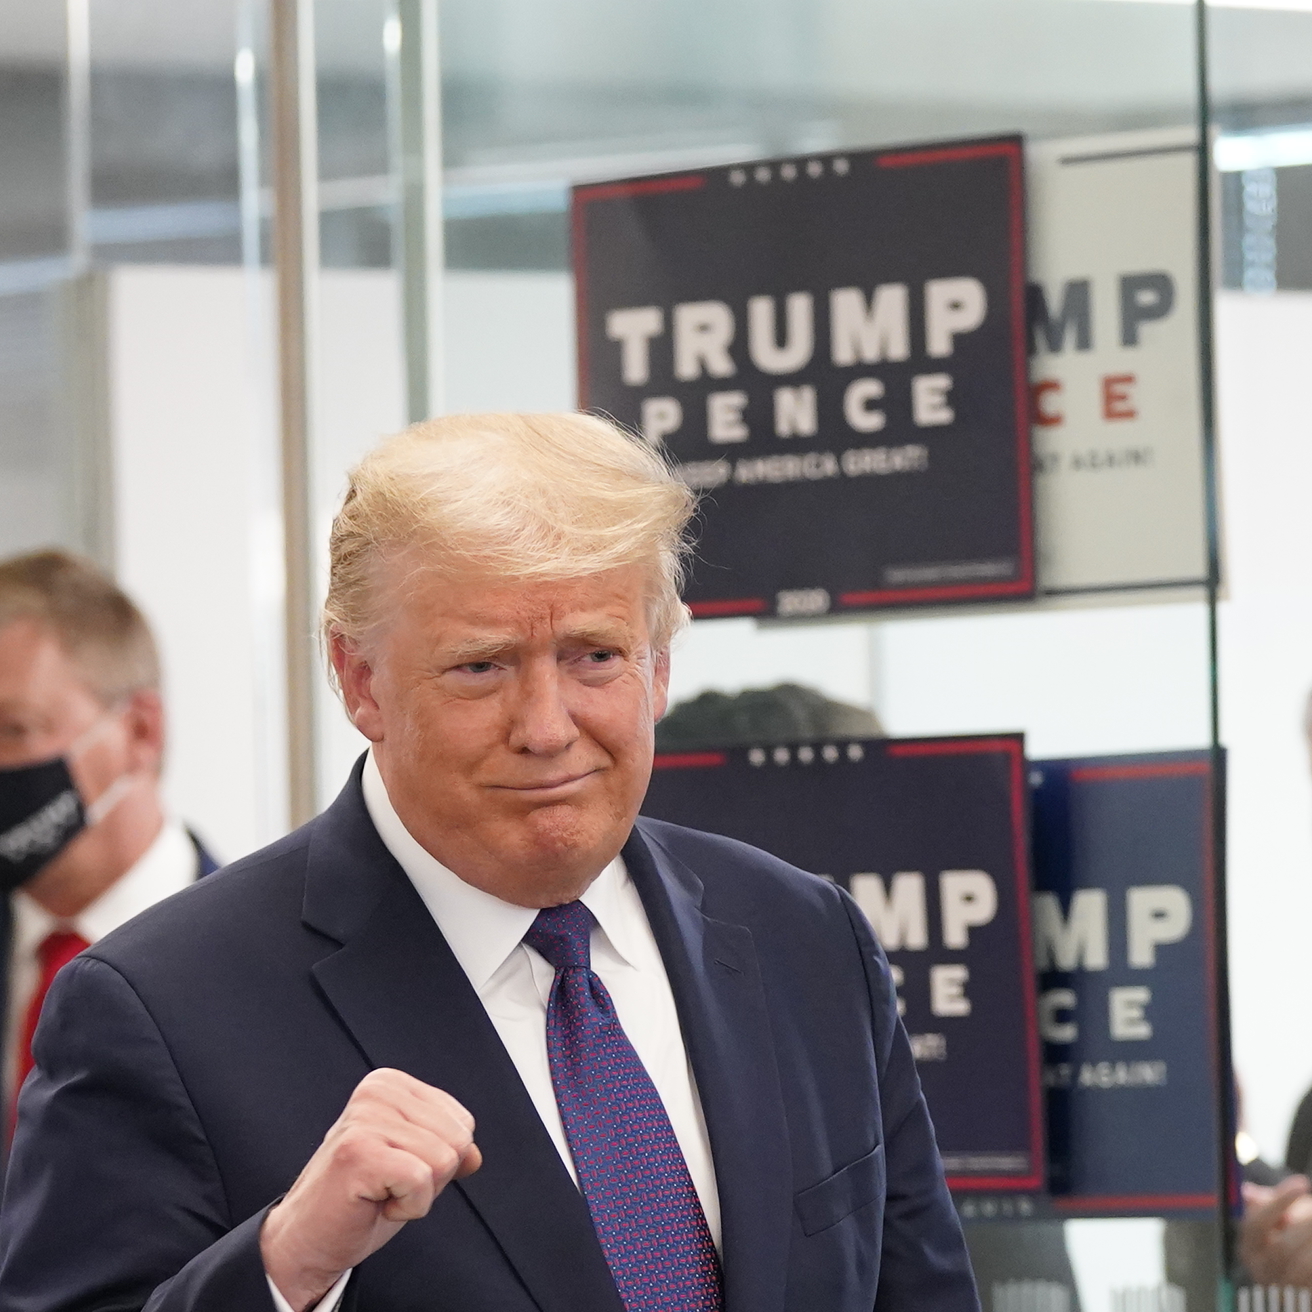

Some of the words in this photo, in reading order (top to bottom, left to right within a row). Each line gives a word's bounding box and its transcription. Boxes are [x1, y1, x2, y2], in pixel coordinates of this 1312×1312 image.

[605, 276, 989, 387] TRUMP
[1025, 269, 1177, 355] MP
[641, 373, 955, 445] PENCE
[735, 451, 839, 484] AMERICA
[841, 443, 929, 477] GREAT!
[828, 869, 999, 952] MP
[1030, 883, 1194, 972] MP
[1038, 985, 1153, 1043] CE
[1076, 1059, 1168, 1089] AGAIN!
